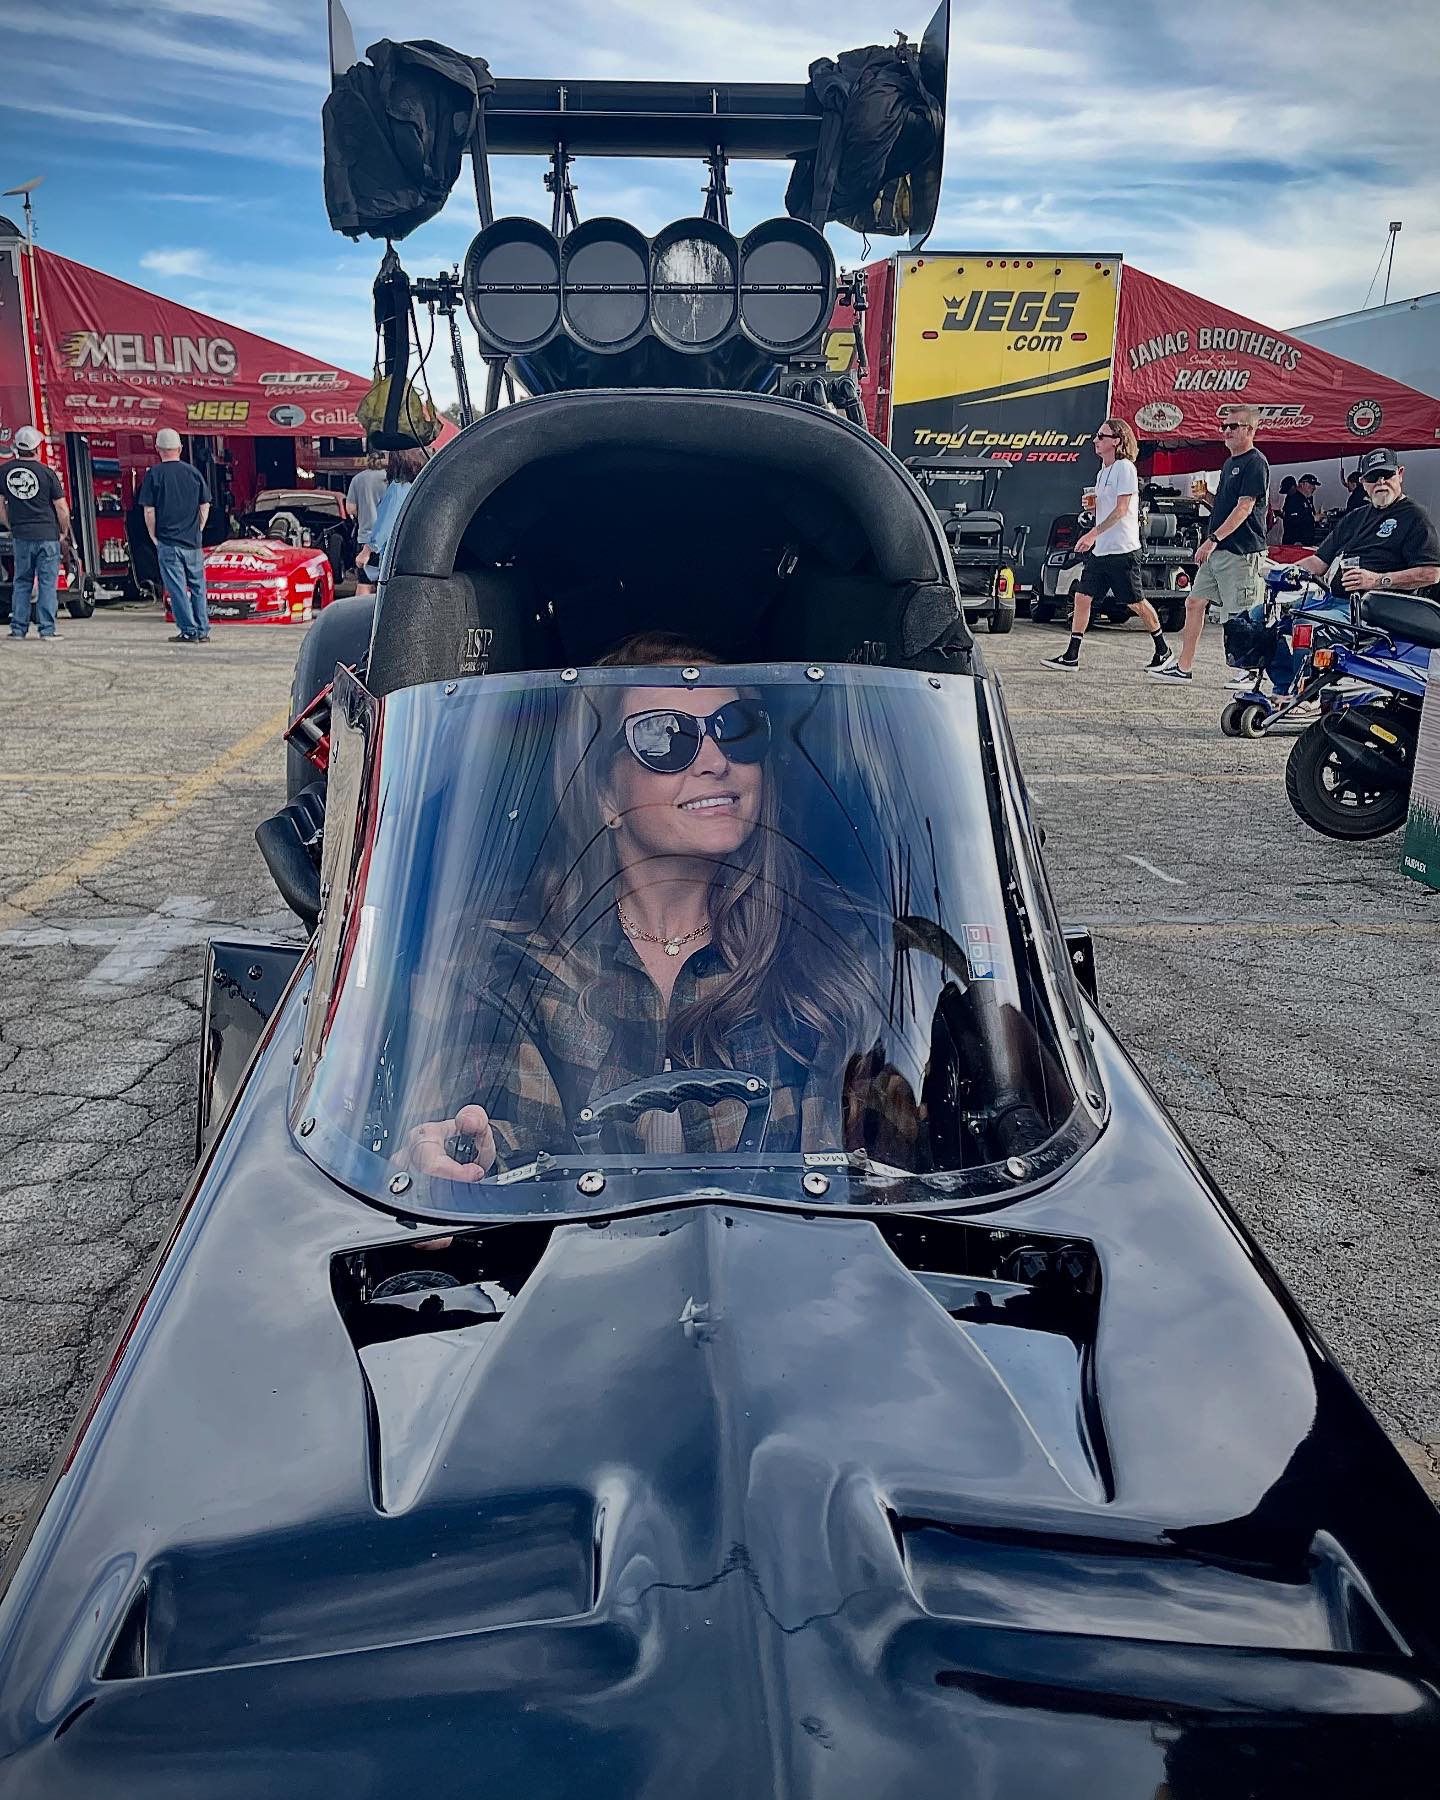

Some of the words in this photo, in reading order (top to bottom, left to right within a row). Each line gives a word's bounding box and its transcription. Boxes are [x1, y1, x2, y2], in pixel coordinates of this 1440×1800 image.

[942, 290, 1080, 332] JEGS
[1006, 335, 1063, 352] .com
[1129, 330, 1190, 371] JANAC
[1199, 327, 1302, 372] BROTHER'S
[70, 331, 237, 375] MELLING
[73, 371, 236, 387] PERFORMANCE
[261, 373, 337, 383] ELITE
[1173, 369, 1251, 392] RACING
[64, 394, 163, 410] ELITE
[187, 400, 250, 421] JEGS
[1348, 400, 1382, 418] ROASTERS
[311, 408, 361, 426] Galla
[913, 429, 966, 449] Troy
[967, 429, 1069, 449] Coughlin
[1026, 452, 1080, 462] STOCK
[204, 554, 278, 571] ELLING
[466, 628, 493, 657] ISP
[1404, 855, 1427, 874] FAIRPLEX
